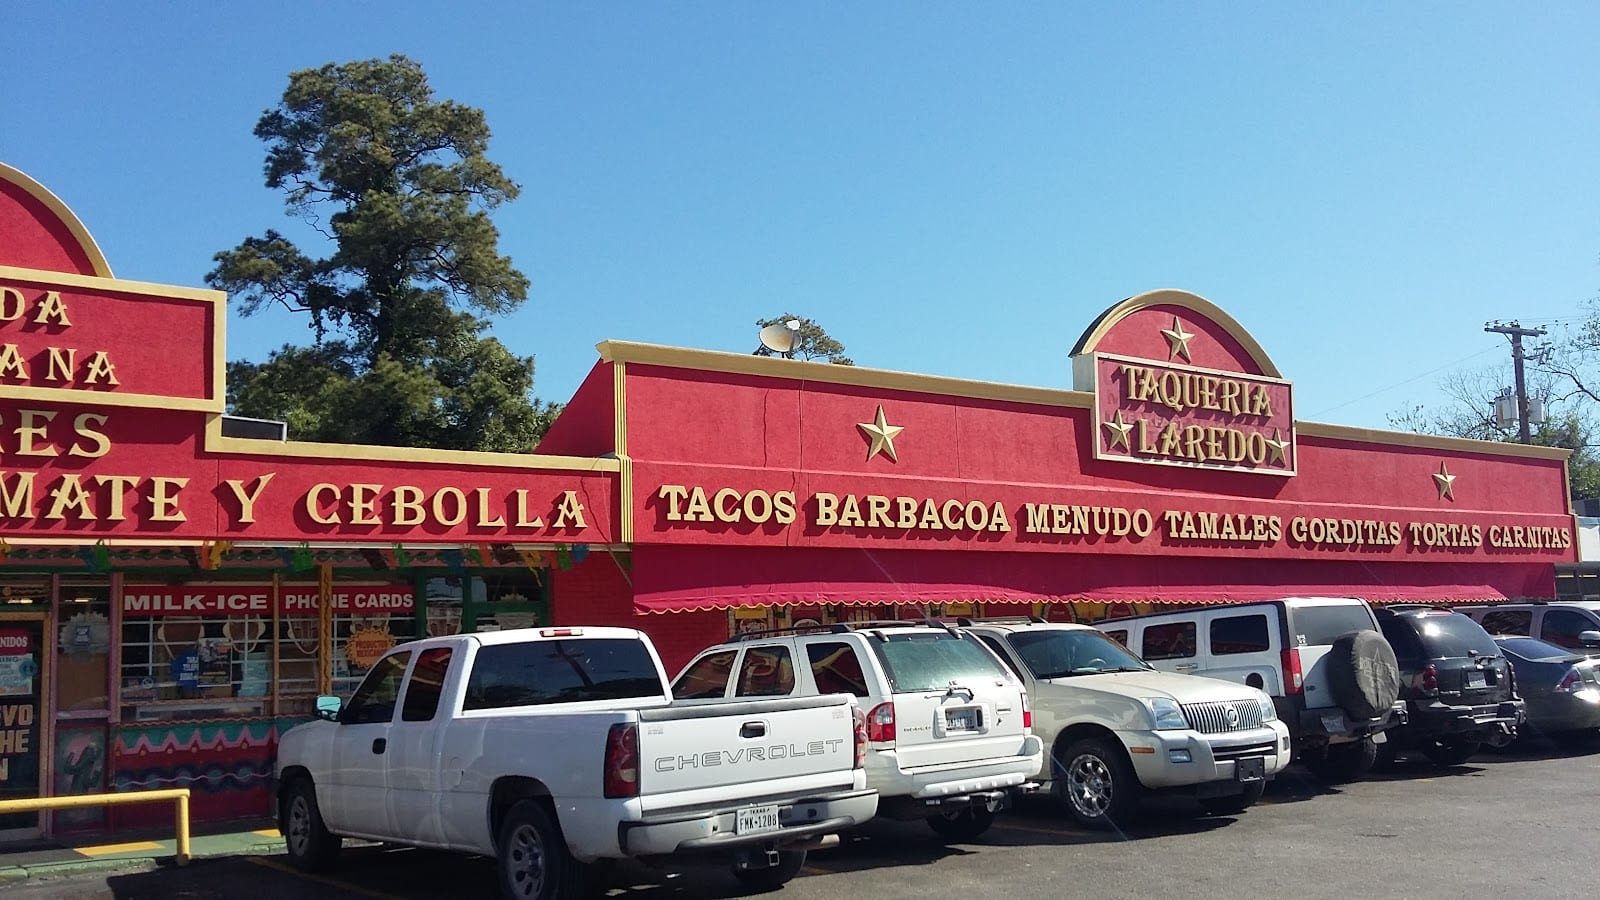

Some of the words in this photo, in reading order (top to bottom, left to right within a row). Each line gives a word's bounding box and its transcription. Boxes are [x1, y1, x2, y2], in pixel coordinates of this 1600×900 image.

[0, 286, 72, 327] DA
[0, 343, 121, 385] ANA
[1120, 365, 1274, 417] TAQUERIA
[0, 409, 111, 458] ES
[1137, 419, 1266, 464] LAREDO
[0, 471, 191, 522] MATE
[226, 473, 276, 523] Y
[306, 483, 588, 529] CEBOLLA
[659, 485, 796, 524] TACOS
[815, 492, 1011, 532] BARBACOA
[1025, 502, 1153, 537] MENUDO
[1164, 510, 1282, 541] TAMALES
[1291, 516, 1401, 545] GORDITAS
[1409, 522, 1482, 547] TORTAS
[1489, 525, 1571, 549] CARNITAS
[124, 594, 267, 611] MILK-ICE
[354, 593, 414, 608] CARDS
[0, 704, 33, 726] VO
[654, 738, 844, 772] CHEVROLET
